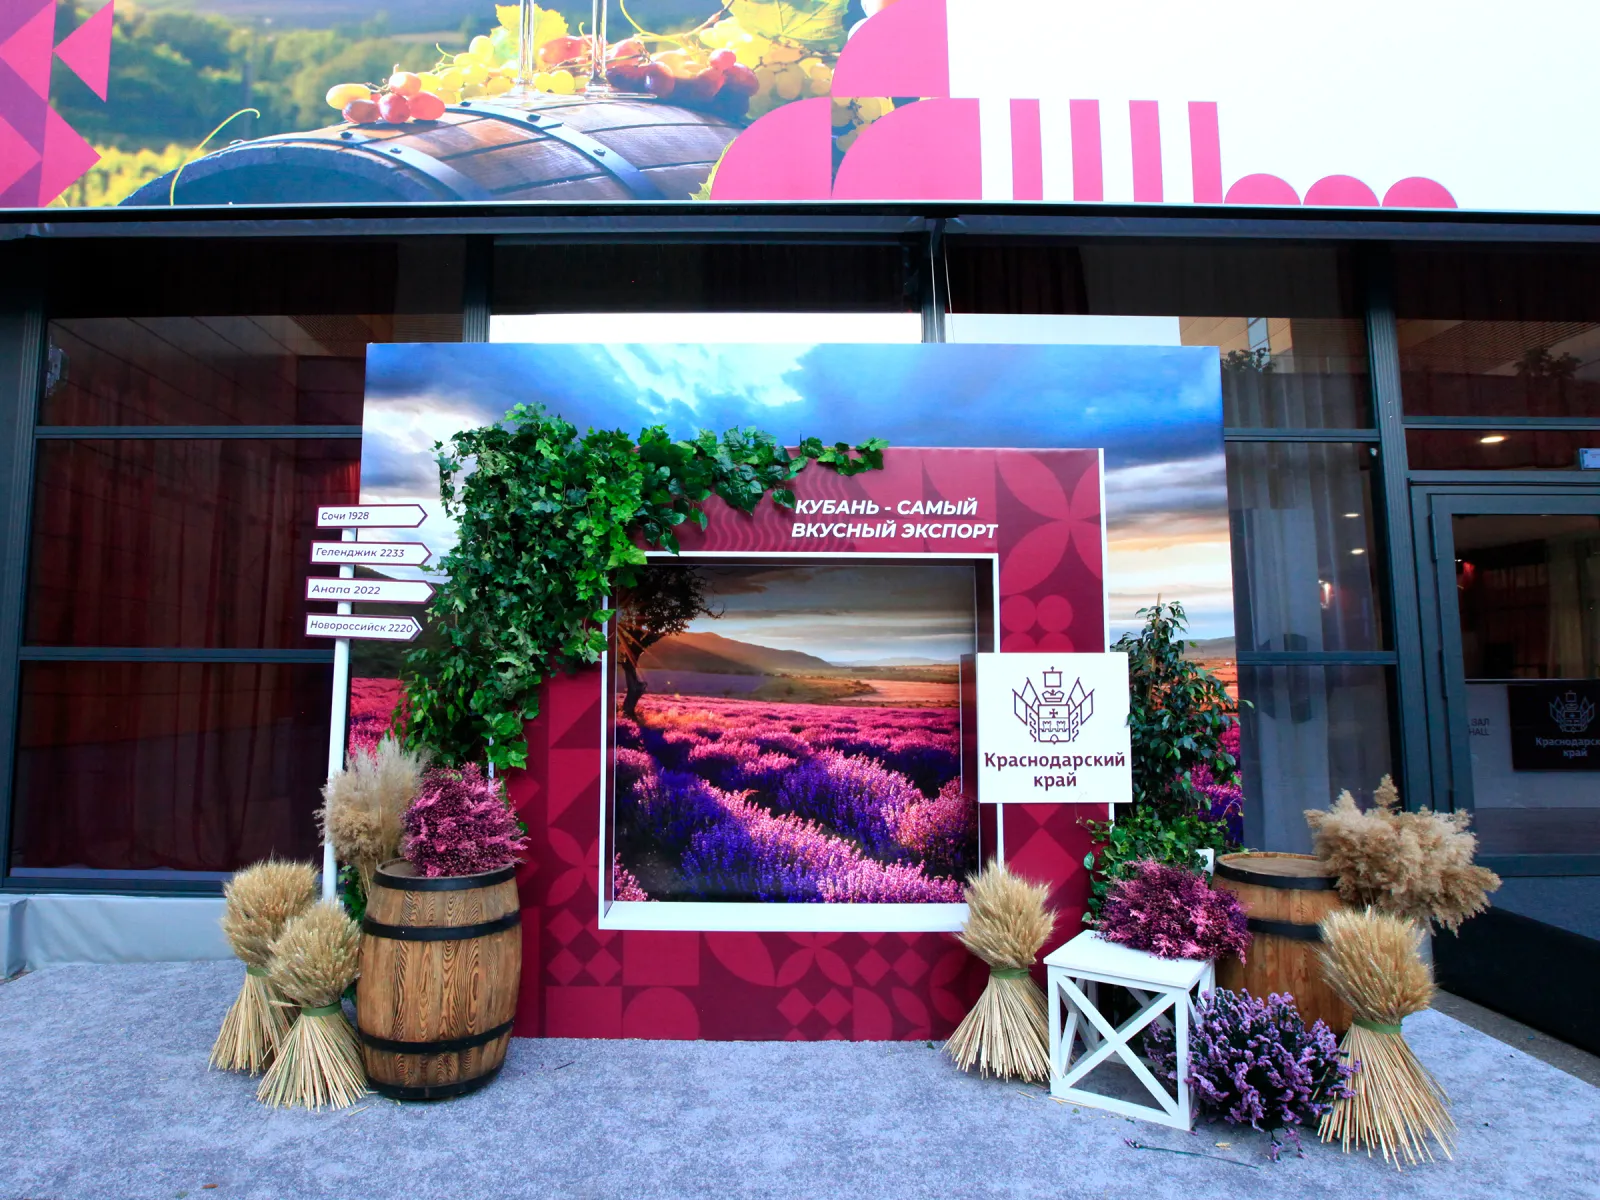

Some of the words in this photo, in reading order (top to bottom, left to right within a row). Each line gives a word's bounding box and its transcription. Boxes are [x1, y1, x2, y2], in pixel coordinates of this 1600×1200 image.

[795, 499, 879, 515] КУБАНЬ
[897, 497, 978, 515] САМЫЙ
[321, 511, 346, 521] Сочи
[348, 511, 370, 520] 1928
[791, 519, 897, 538] ВКУСНЫЙ
[901, 523, 999, 539] ЭКСПОРТ
[315, 547, 377, 558] Геленджик
[380, 548, 405, 558] 2233
[311, 584, 351, 594] Анапа
[353, 585, 381, 595] 2022
[310, 620, 387, 632] Новороссийск
[388, 623, 413, 633] 2220
[1562, 748, 1588, 759] край
[984, 752, 1125, 771] Краснодарский
[1033, 772, 1077, 791] край
